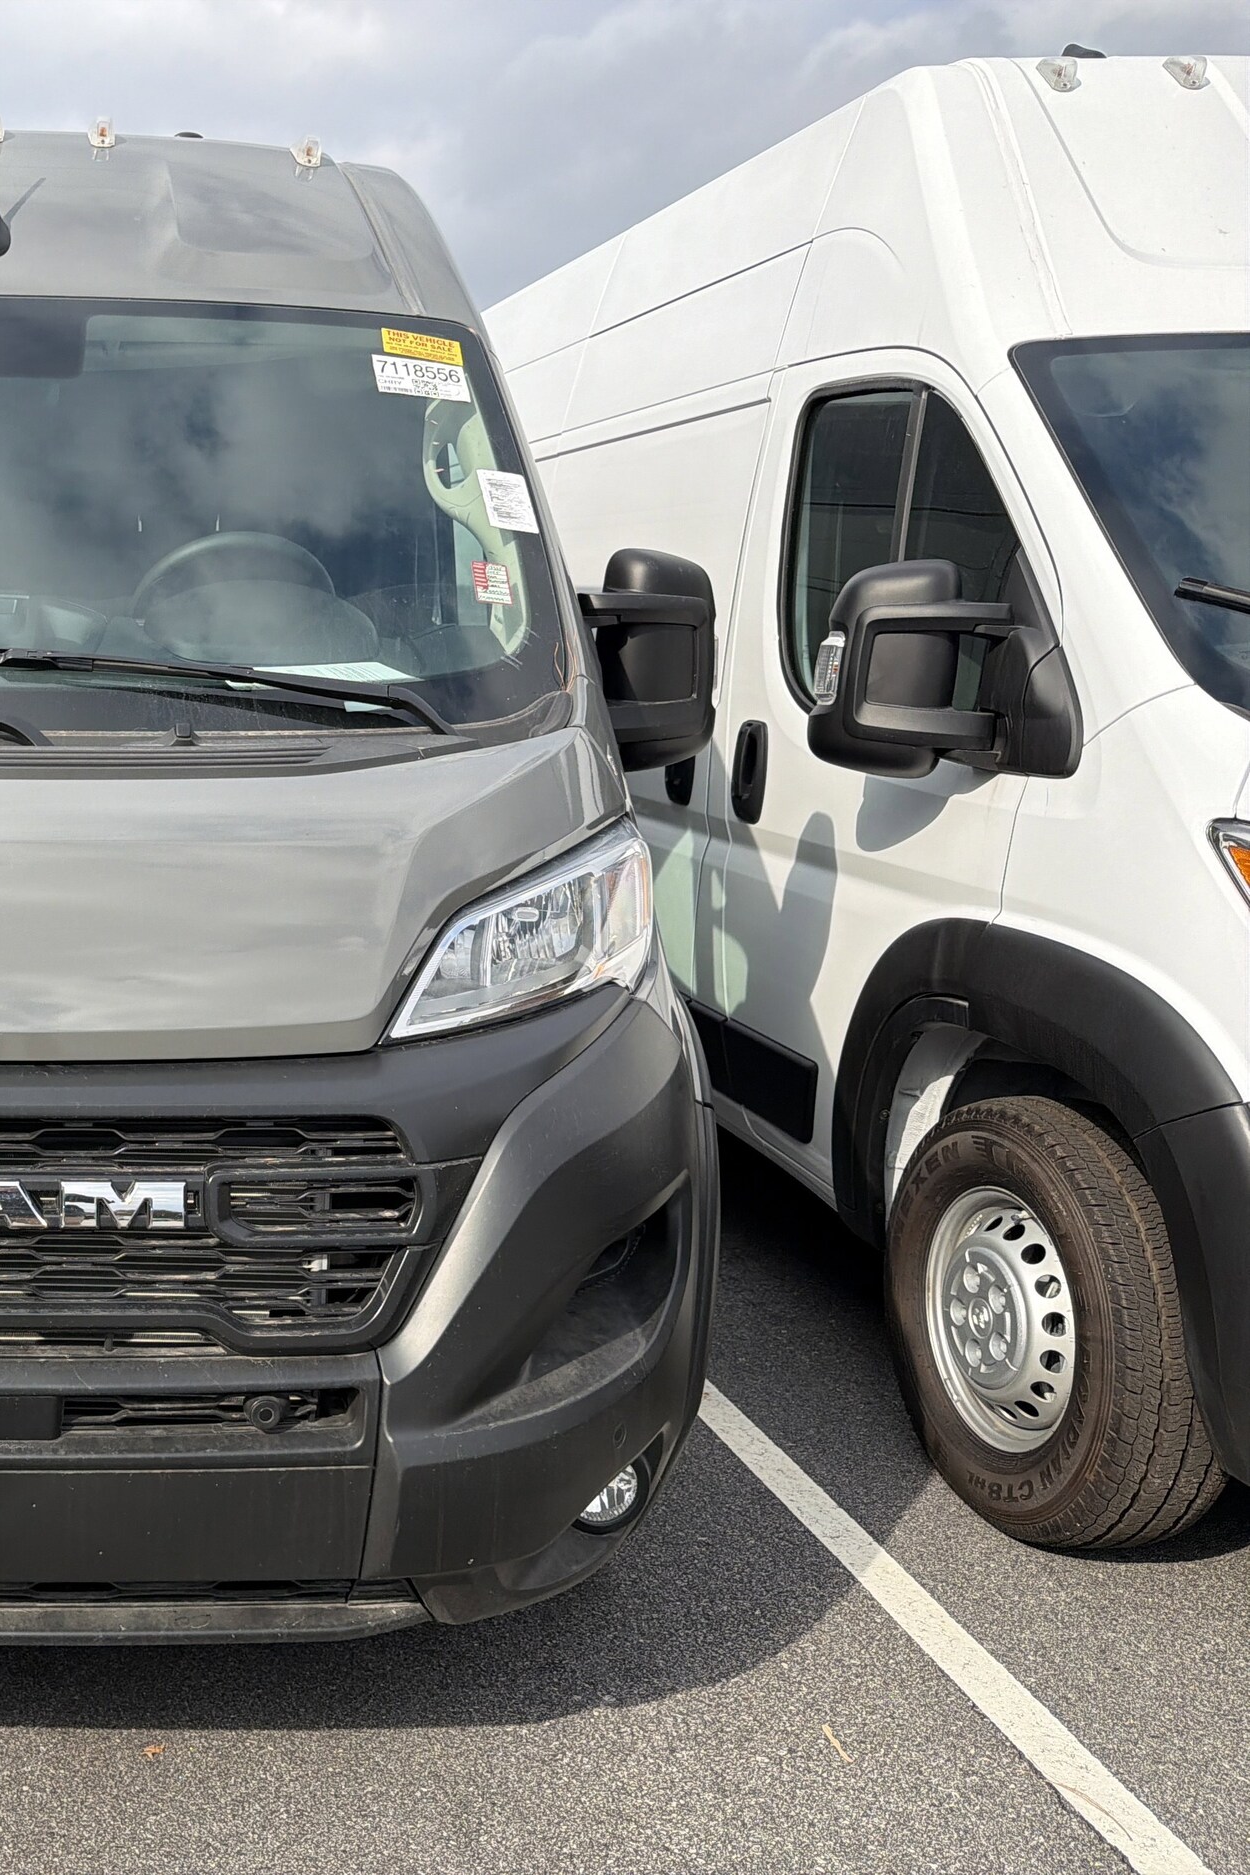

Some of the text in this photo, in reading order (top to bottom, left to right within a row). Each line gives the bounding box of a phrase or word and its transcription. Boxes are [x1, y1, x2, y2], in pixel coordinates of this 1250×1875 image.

[386, 330, 456, 348] THIS VEHICLE
[388, 336, 407, 344] NOT
[410, 340, 428, 348] FOR
[430, 344, 454, 353] SALE
[376, 359, 461, 384] 7118556
